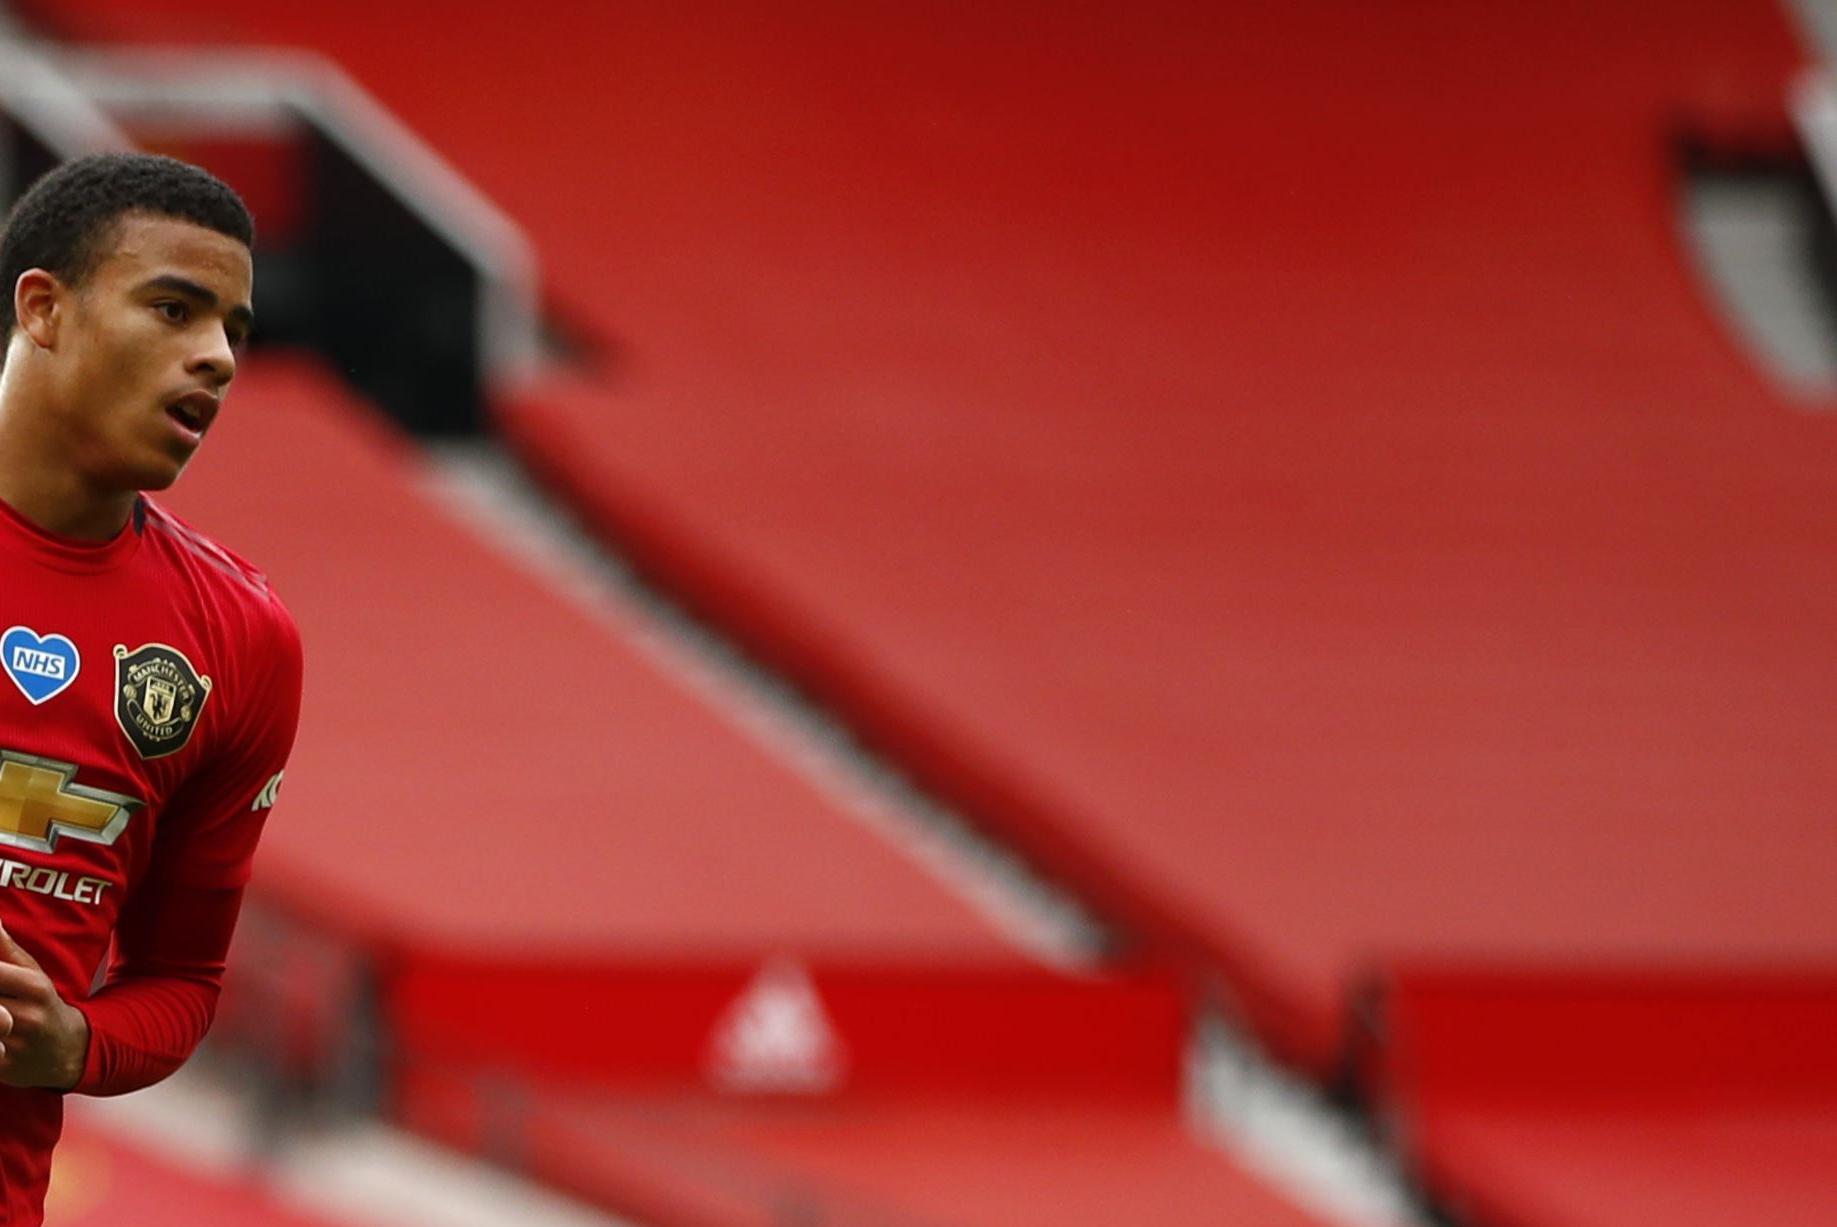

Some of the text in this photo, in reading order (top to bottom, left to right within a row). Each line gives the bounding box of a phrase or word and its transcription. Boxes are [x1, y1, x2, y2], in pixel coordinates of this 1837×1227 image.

[15, 651, 62, 675] NHS
[132, 664, 190, 701] MANCHESTER
[135, 713, 173, 736] UNITED
